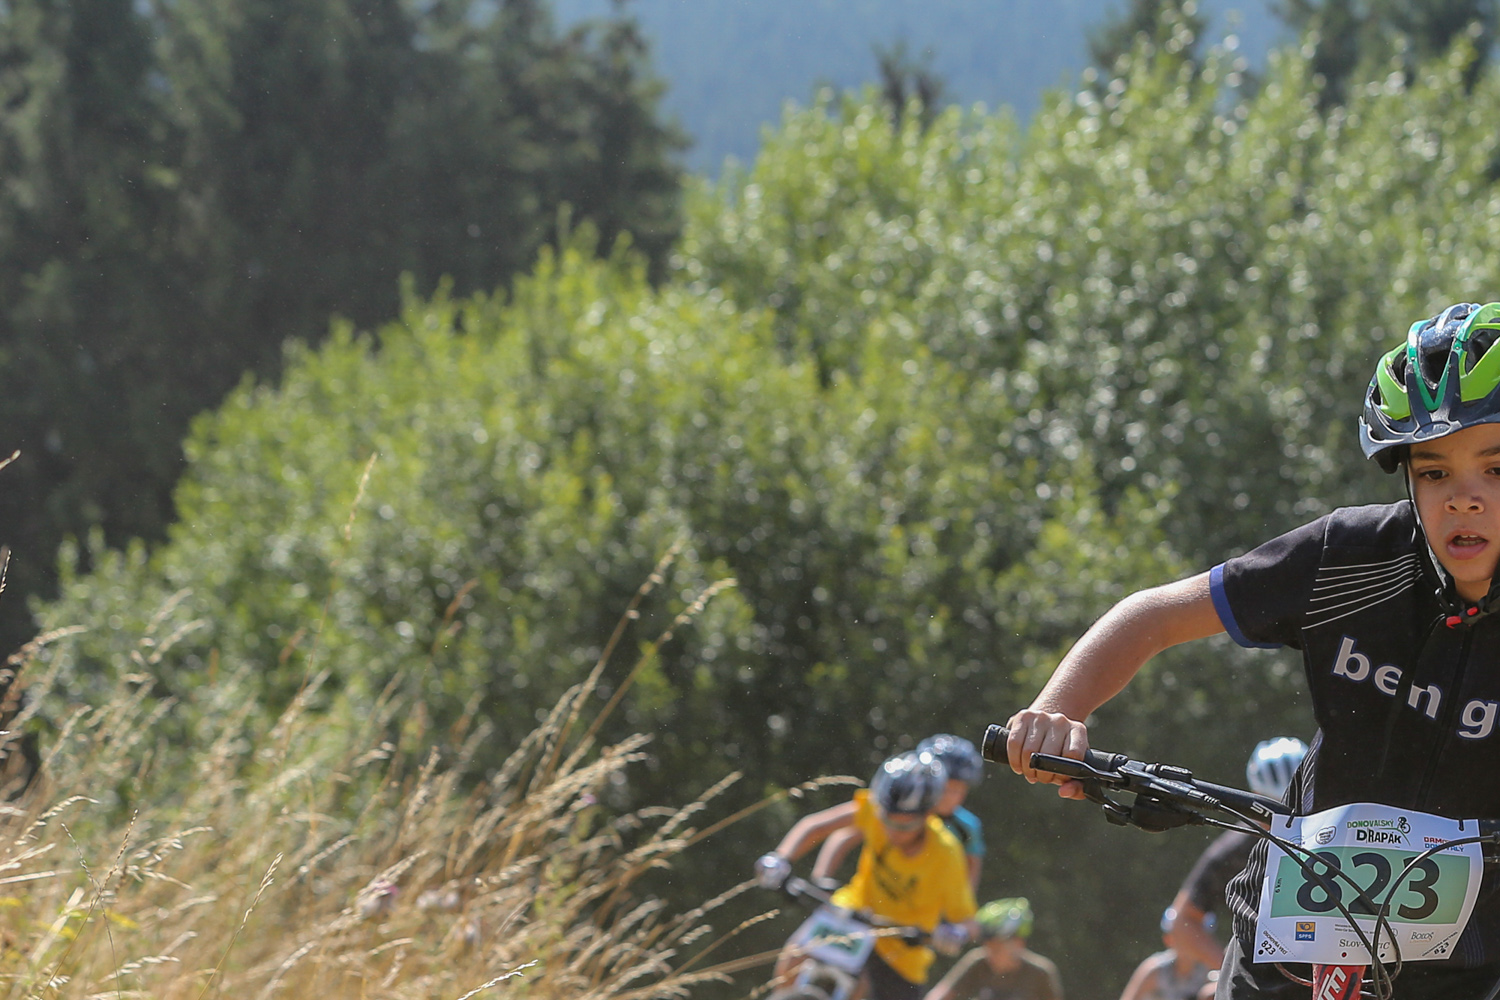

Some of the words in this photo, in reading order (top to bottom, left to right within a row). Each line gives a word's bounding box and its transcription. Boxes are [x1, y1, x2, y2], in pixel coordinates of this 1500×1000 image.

[1356, 827, 1402, 844] DRAPÁK
[1296, 851, 1440, 920] 823
[1261, 940, 1276, 955] 823
